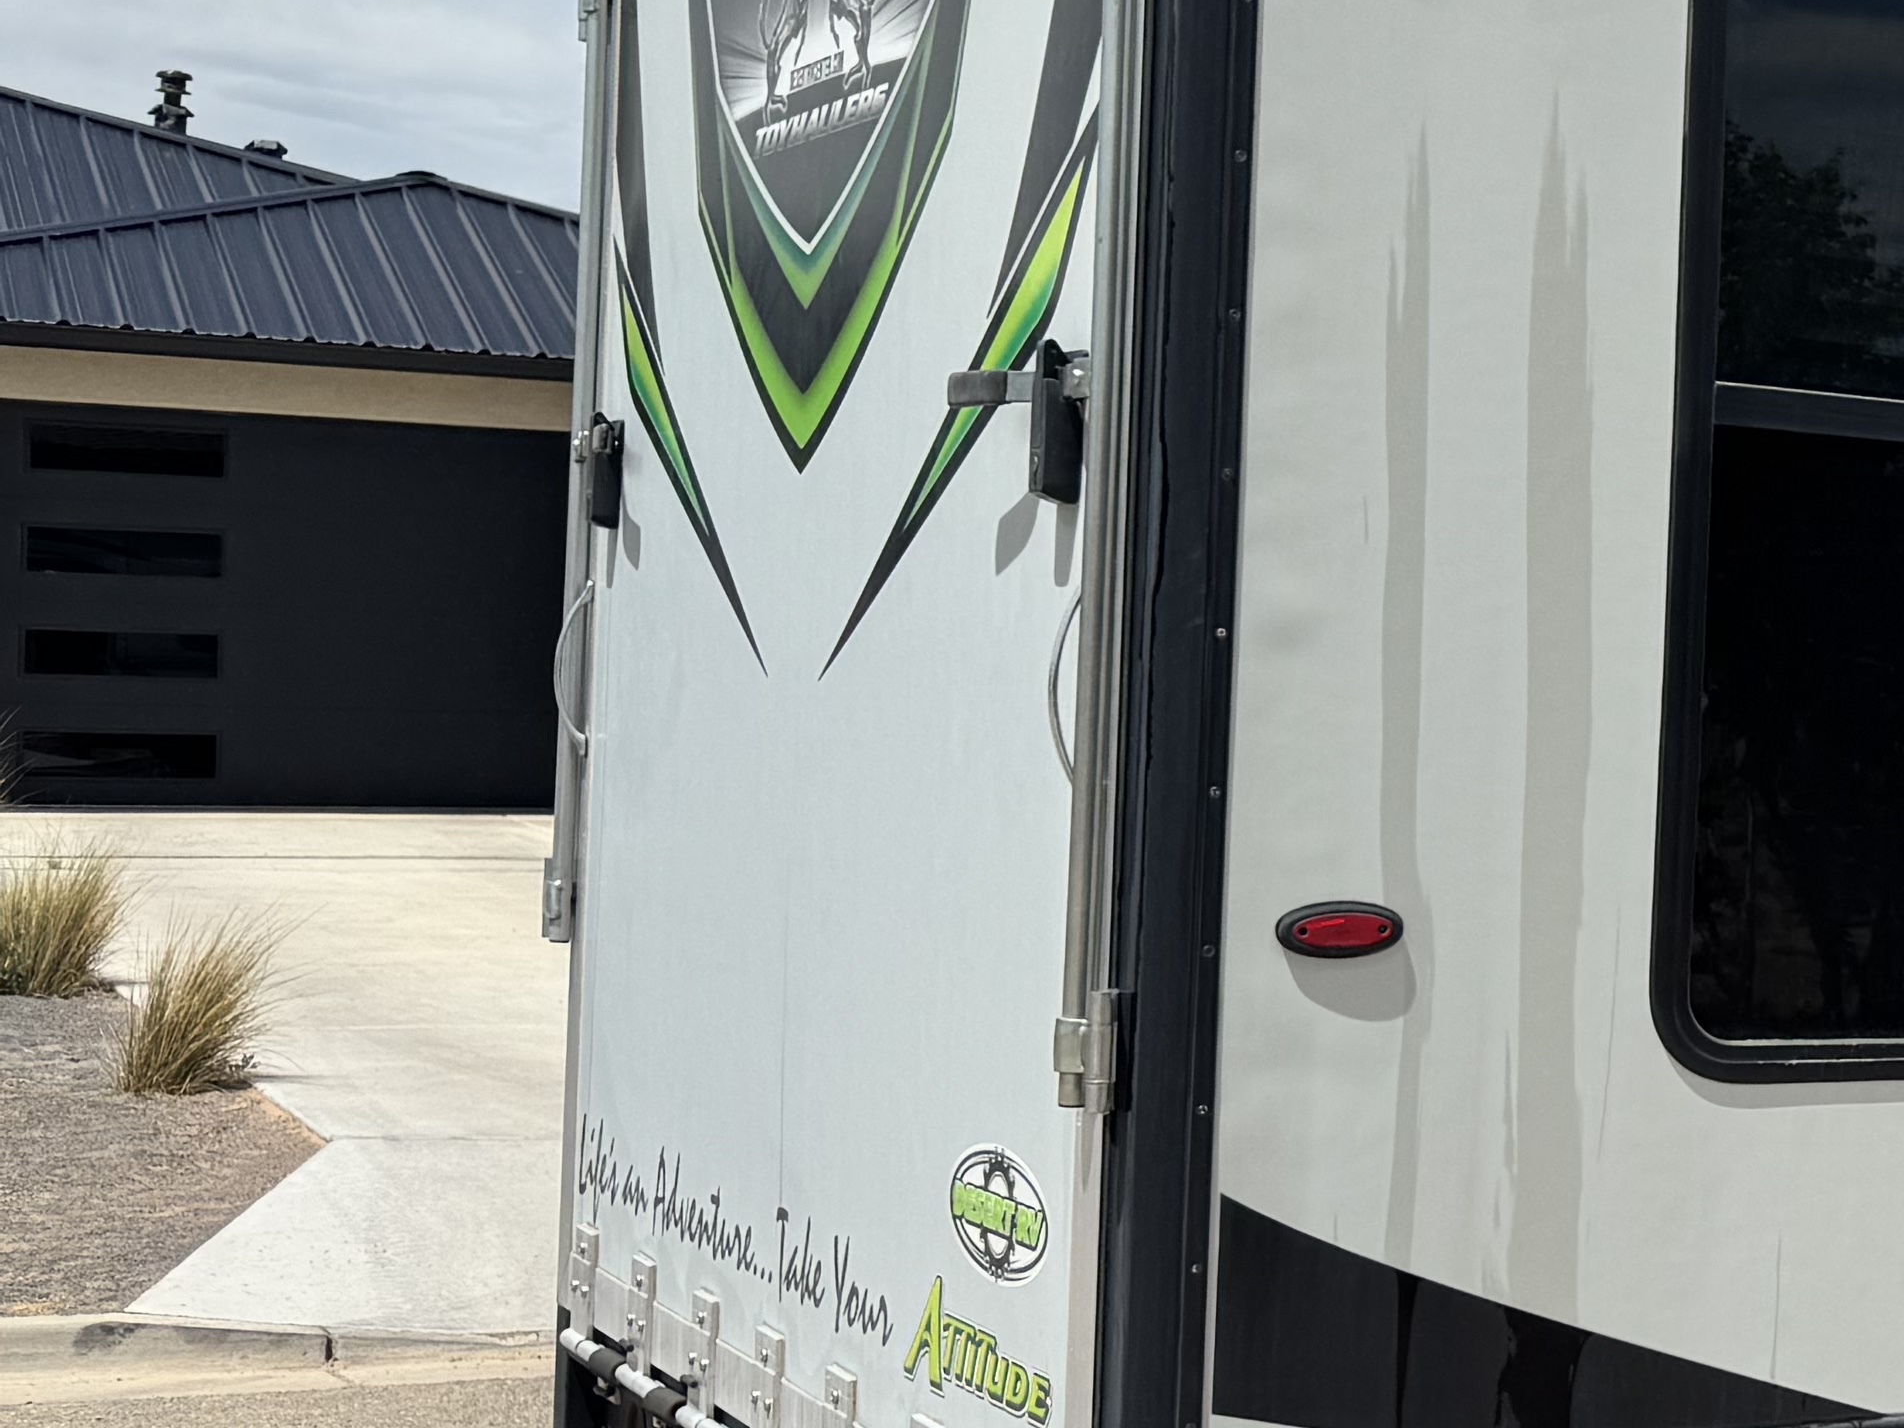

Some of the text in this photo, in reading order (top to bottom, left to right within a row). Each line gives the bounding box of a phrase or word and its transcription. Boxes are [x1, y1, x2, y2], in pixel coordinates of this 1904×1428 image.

[578, 1113, 619, 1227] Life's
[621, 1164, 648, 1217] an
[833, 1234, 894, 1348] Your
[951, 1177, 1044, 1251] DESERT RV
